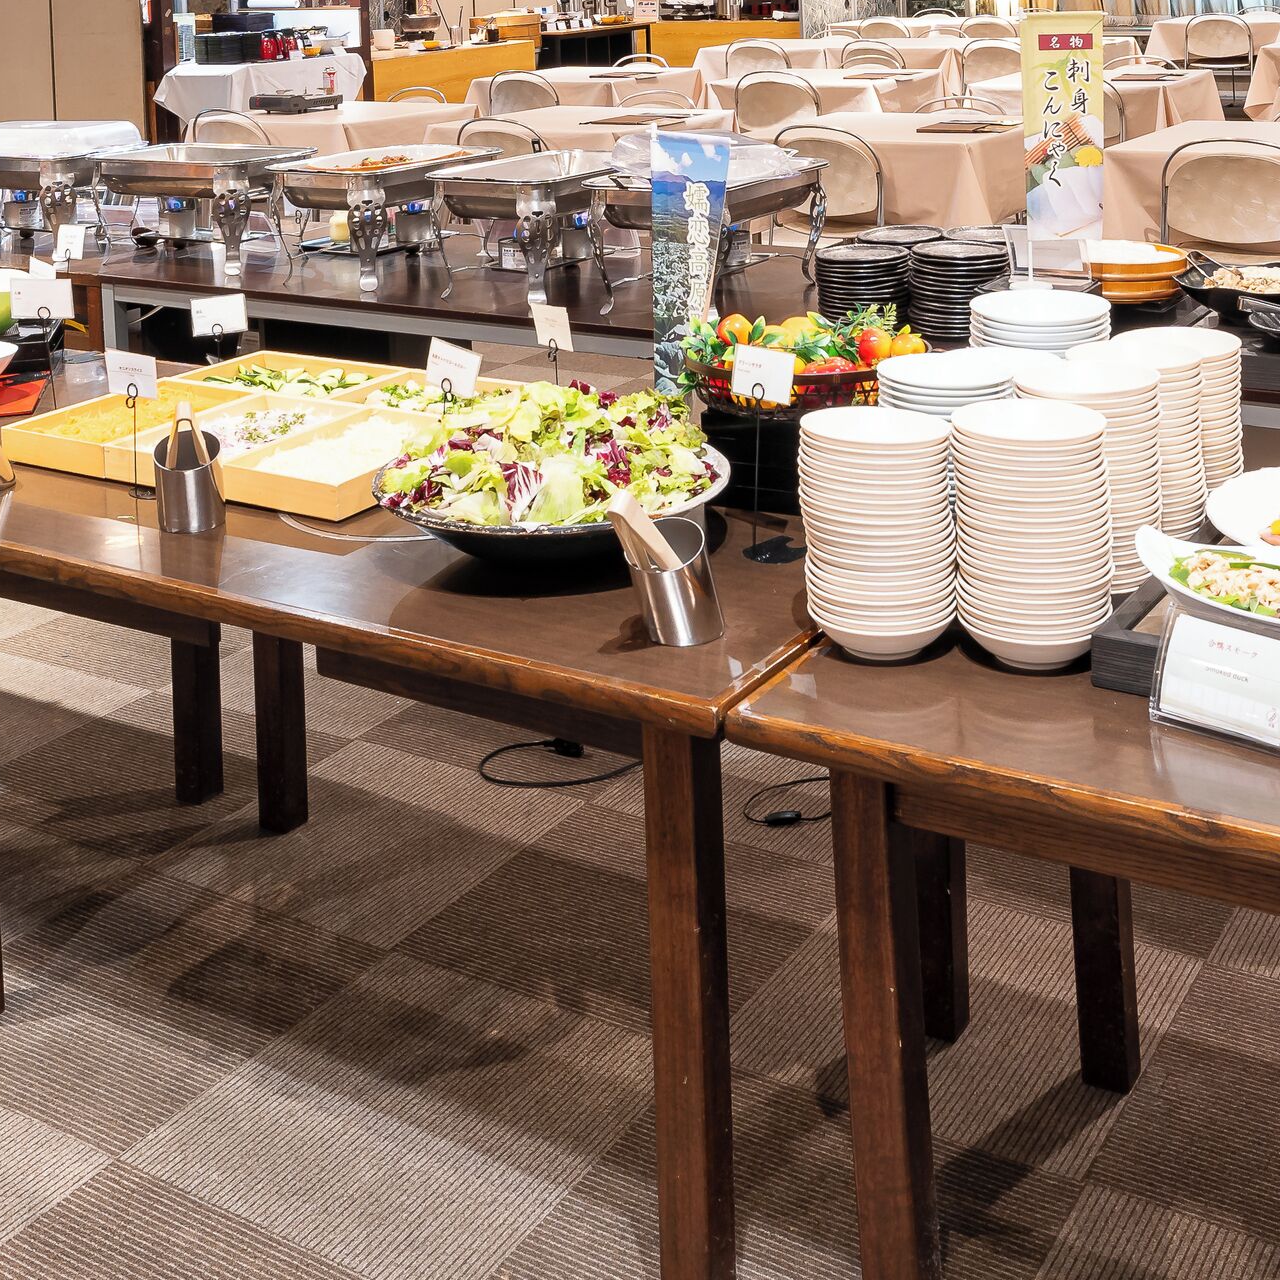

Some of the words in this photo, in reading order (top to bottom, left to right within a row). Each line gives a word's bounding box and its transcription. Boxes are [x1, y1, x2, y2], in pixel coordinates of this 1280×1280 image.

[1049, 36, 1084, 49] 名物
[1067, 59, 1090, 114] 刺身
[1043, 71, 1066, 187] こんにゃく
